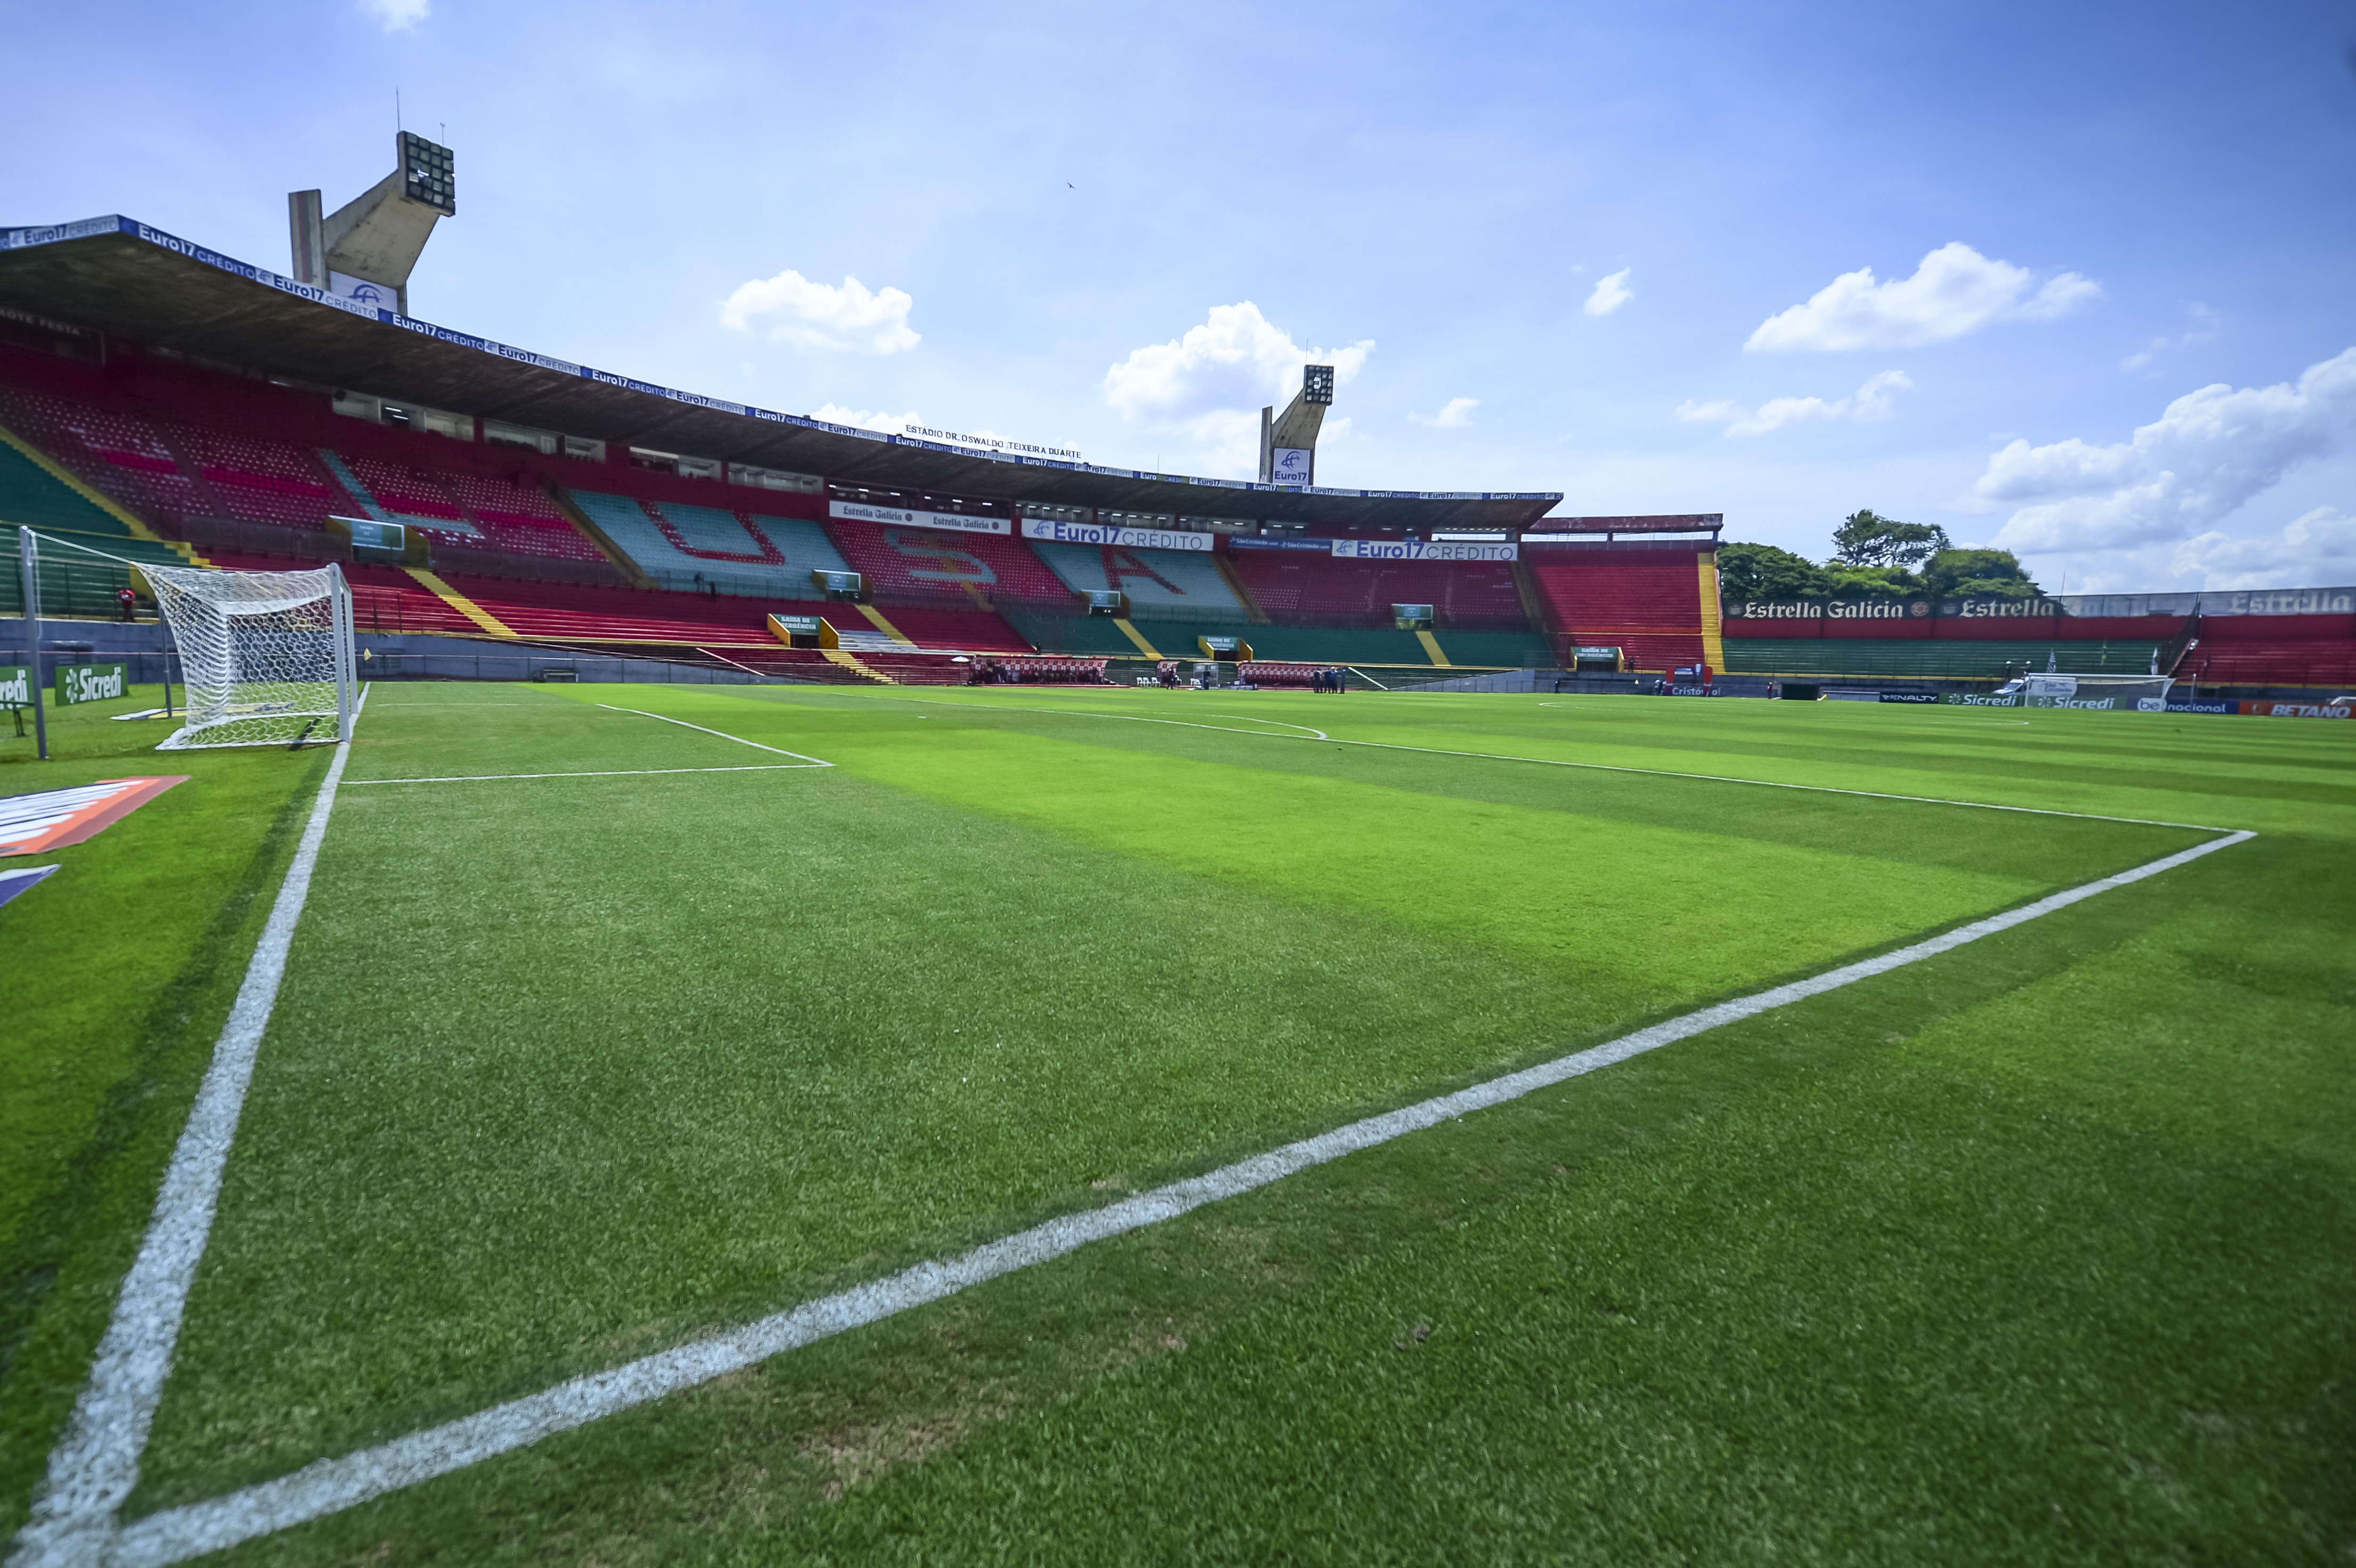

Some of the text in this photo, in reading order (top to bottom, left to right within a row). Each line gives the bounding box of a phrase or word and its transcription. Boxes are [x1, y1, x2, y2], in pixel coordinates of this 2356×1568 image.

[24, 224, 67, 244] Euro17
[68, 219, 117, 238] CRÉDITO
[138, 223, 255, 279] Euro17 CRÉDITO
[273, 274, 377, 319] Euro17 CRÉDITO
[392, 313, 484, 350] Euro17 CRÉDITO
[498, 344, 579, 375] Euro17 CRÉDITO
[592, 370, 665, 397] Euro17 CRÉDITO
[676, 391, 744, 414] Euro17 CRÉDITO
[754, 409, 818, 429] Euro17 CRÉDITO
[827, 423, 887, 441] Euro17 CRÉDITO
[895, 436, 952, 452] Euro17 CRÉDITO
[906, 425, 1081, 459] ESTÁDIO DR. OSWALDO TEIXEIRA DUARTE
[960, 448, 1015, 462] Euro17 CRÉDITO
[1023, 457, 1074, 470] Euro17 CRÉDITO
[1083, 463, 1107, 474] Euro17
[1274, 471, 1307, 481] Euro17
[1221, 480, 1246, 488] CRÉDITO
[843, 505, 902, 521] Estrella Galicia
[933, 516, 989, 529] Estrella Galicia
[1054, 521, 1202, 550] Euro17 CRÉDITO
[1356, 541, 1514, 560] Euro17 CRÉDITO
[1743, 601, 1821, 619] Estrella
[1828, 600, 1904, 619] Galicia
[1959, 599, 2054, 618] Estrella
[2229, 591, 2351, 612] Estrella
[79, 666, 121, 701] Sicredi
[1963, 694, 2018, 707] Sicredi
[2053, 696, 2115, 709] Sicredi
[2271, 704, 2351, 718] BETANO
